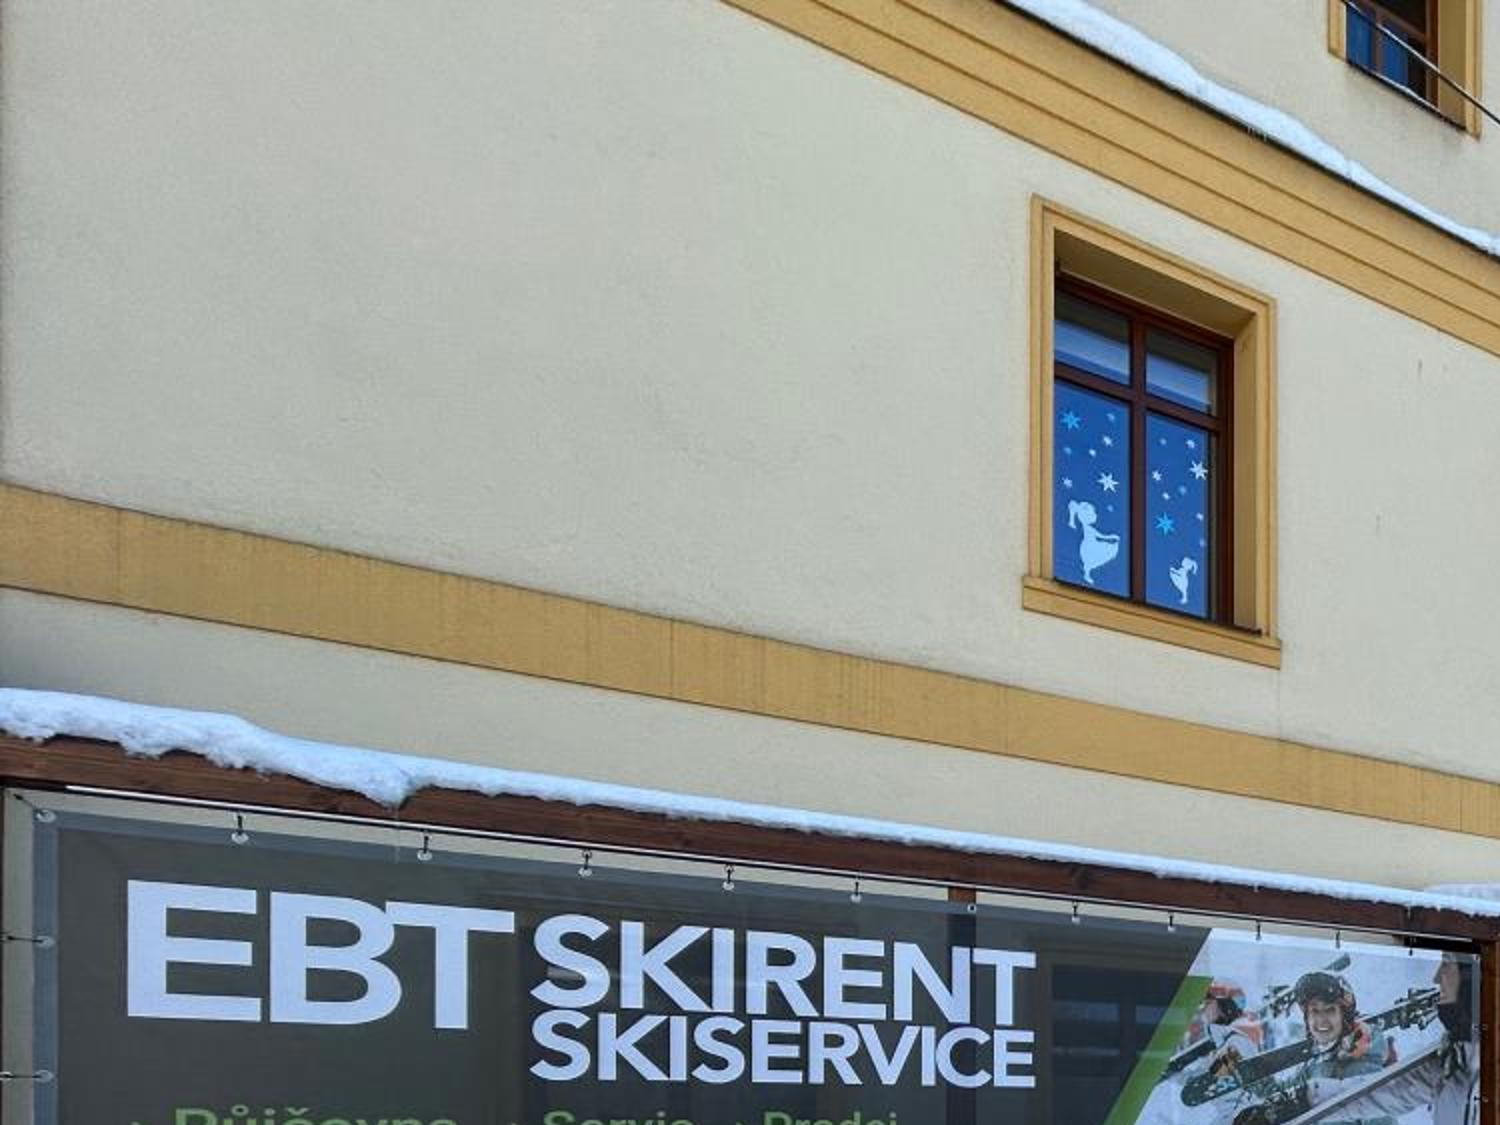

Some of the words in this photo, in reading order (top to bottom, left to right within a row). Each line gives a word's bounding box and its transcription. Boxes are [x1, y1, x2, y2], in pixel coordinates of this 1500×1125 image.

[127, 879, 516, 1030] EBT
[529, 913, 1038, 1027] SKIRENT
[529, 1009, 1037, 1088] SKISERVICE
